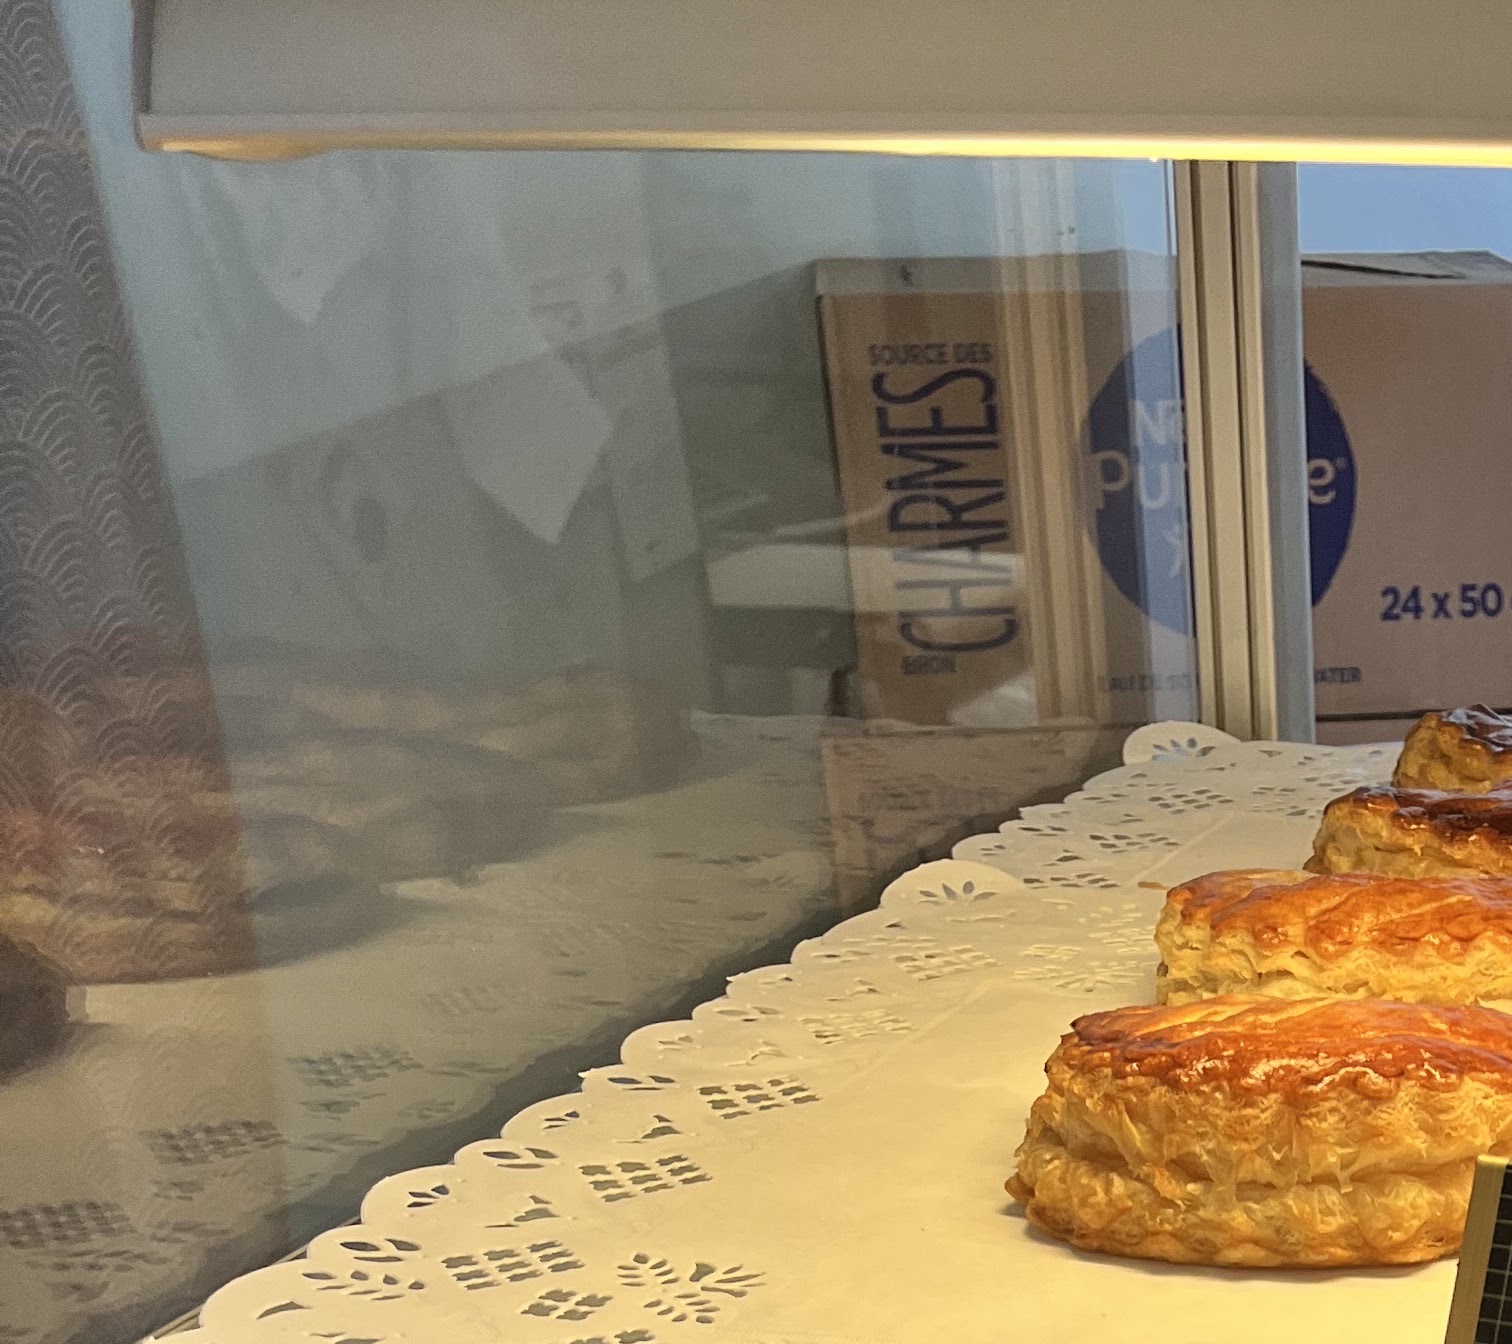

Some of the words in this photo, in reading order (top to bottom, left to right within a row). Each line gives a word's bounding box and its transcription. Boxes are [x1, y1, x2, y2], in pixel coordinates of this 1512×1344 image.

[871, 367, 1019, 652] CHARMES
[1380, 585, 1425, 622] 24
[1431, 591, 1453, 619] x
[1459, 582, 1504, 618] 50
